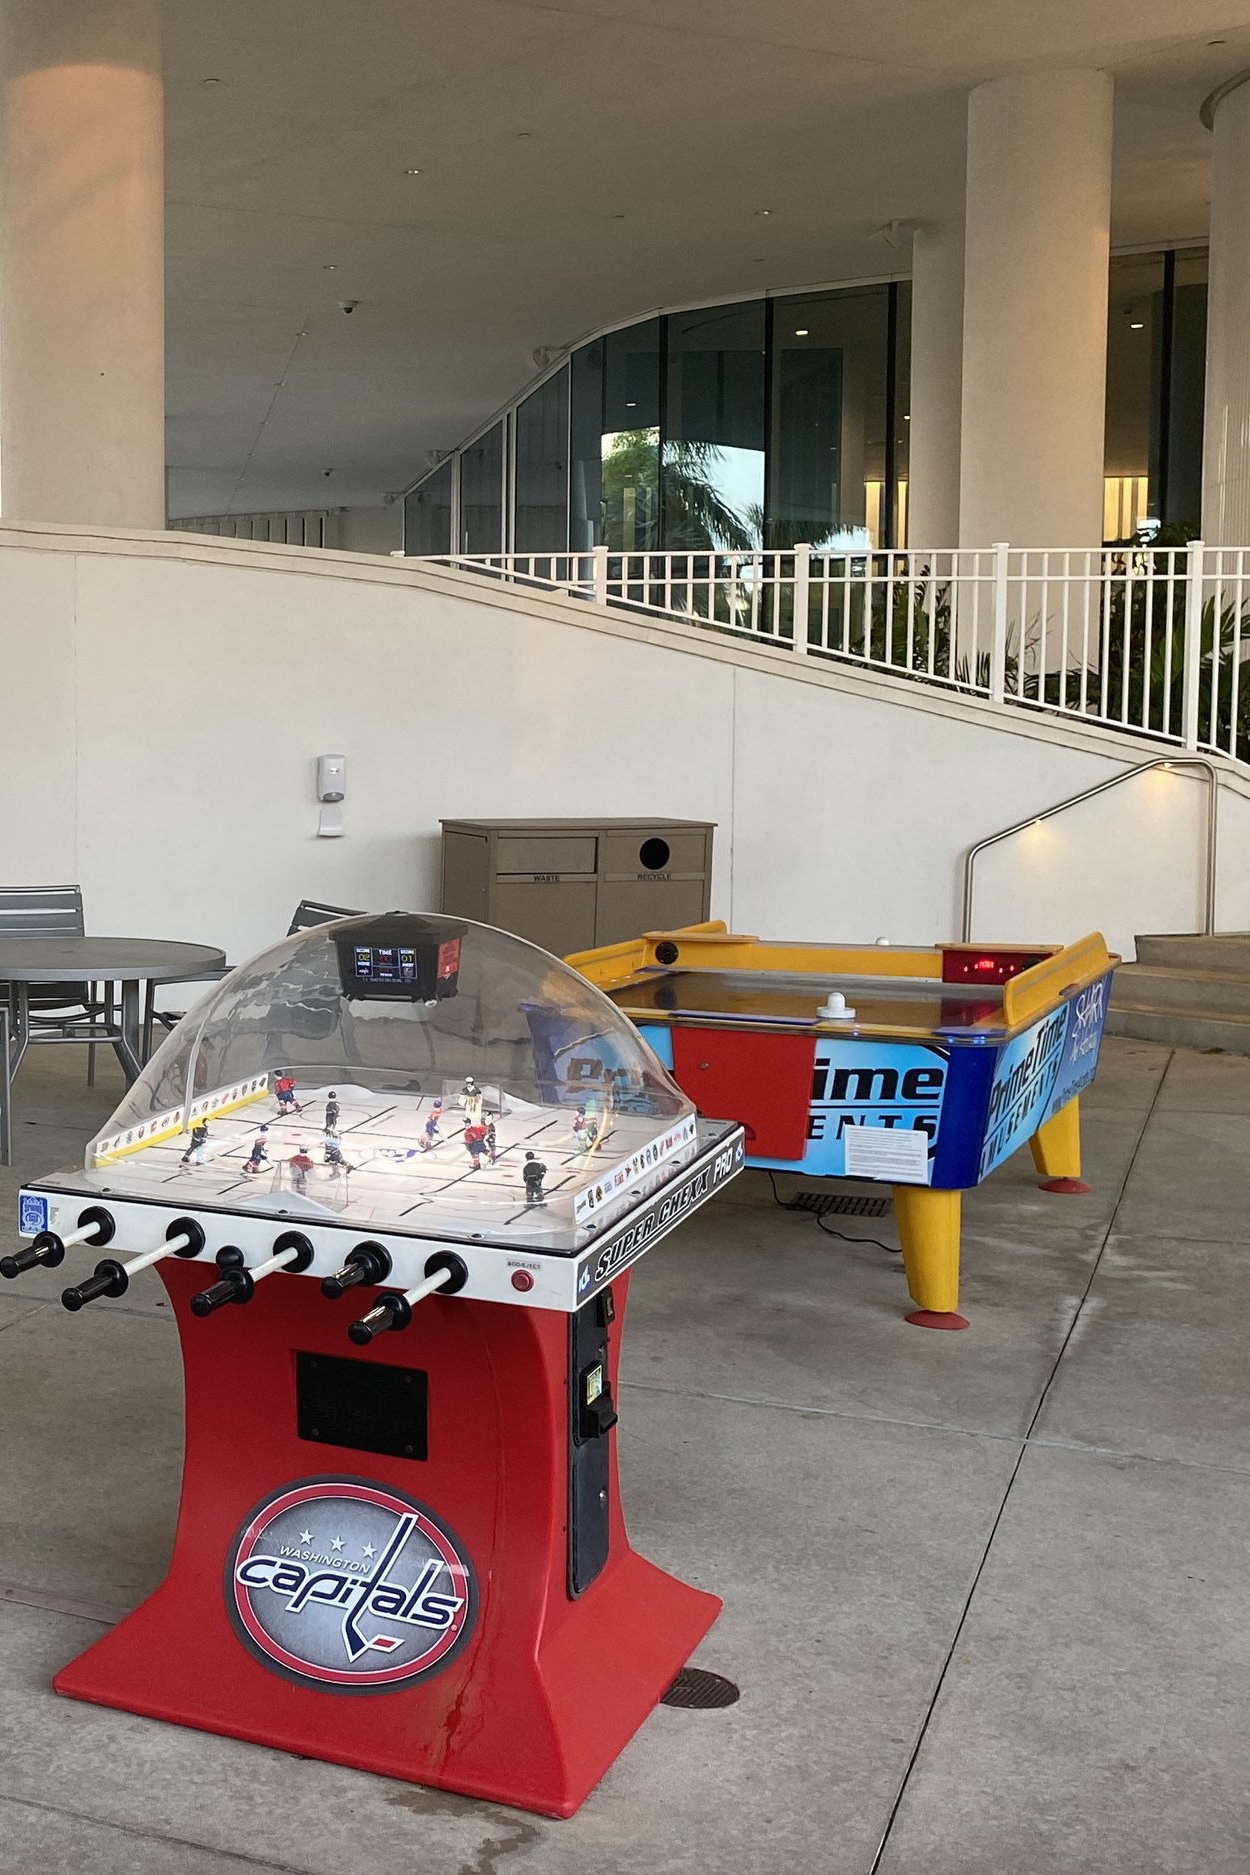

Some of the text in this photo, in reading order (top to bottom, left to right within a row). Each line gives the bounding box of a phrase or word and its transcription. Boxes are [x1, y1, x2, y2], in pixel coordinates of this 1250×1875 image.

[401, 954, 412, 962] 01
[810, 1057, 944, 1100] ime
[979, 1054, 1060, 1179] AMUSEMENTS
[595, 1148, 733, 1283] SUPER CHEXX PRO
[236, 1512, 465, 1663] capitals
[280, 1545, 371, 1574] WASHINGTON
